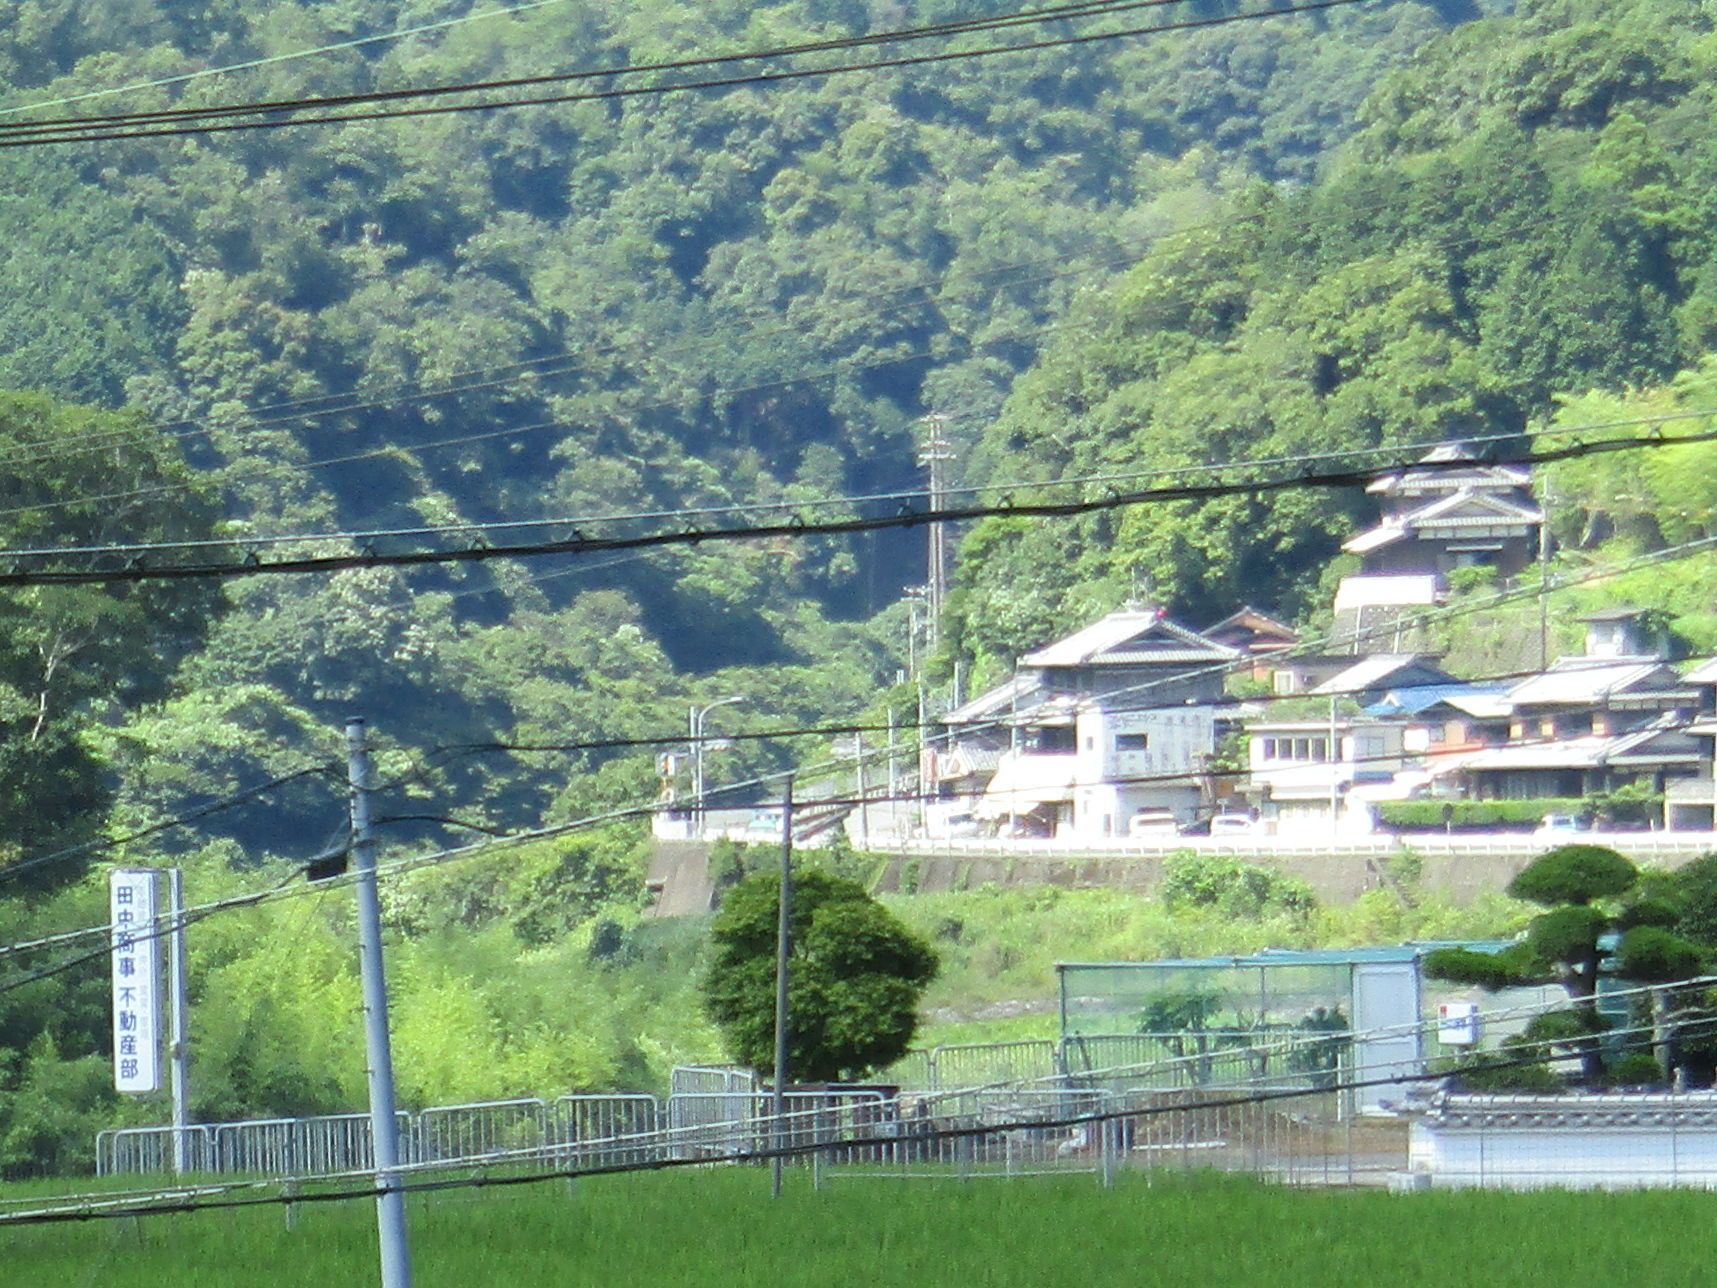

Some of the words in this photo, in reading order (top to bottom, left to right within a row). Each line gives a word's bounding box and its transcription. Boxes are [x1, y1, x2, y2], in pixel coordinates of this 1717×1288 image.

[117, 886, 136, 978] 田中商事
[119, 986, 139, 1080] 不動産部
